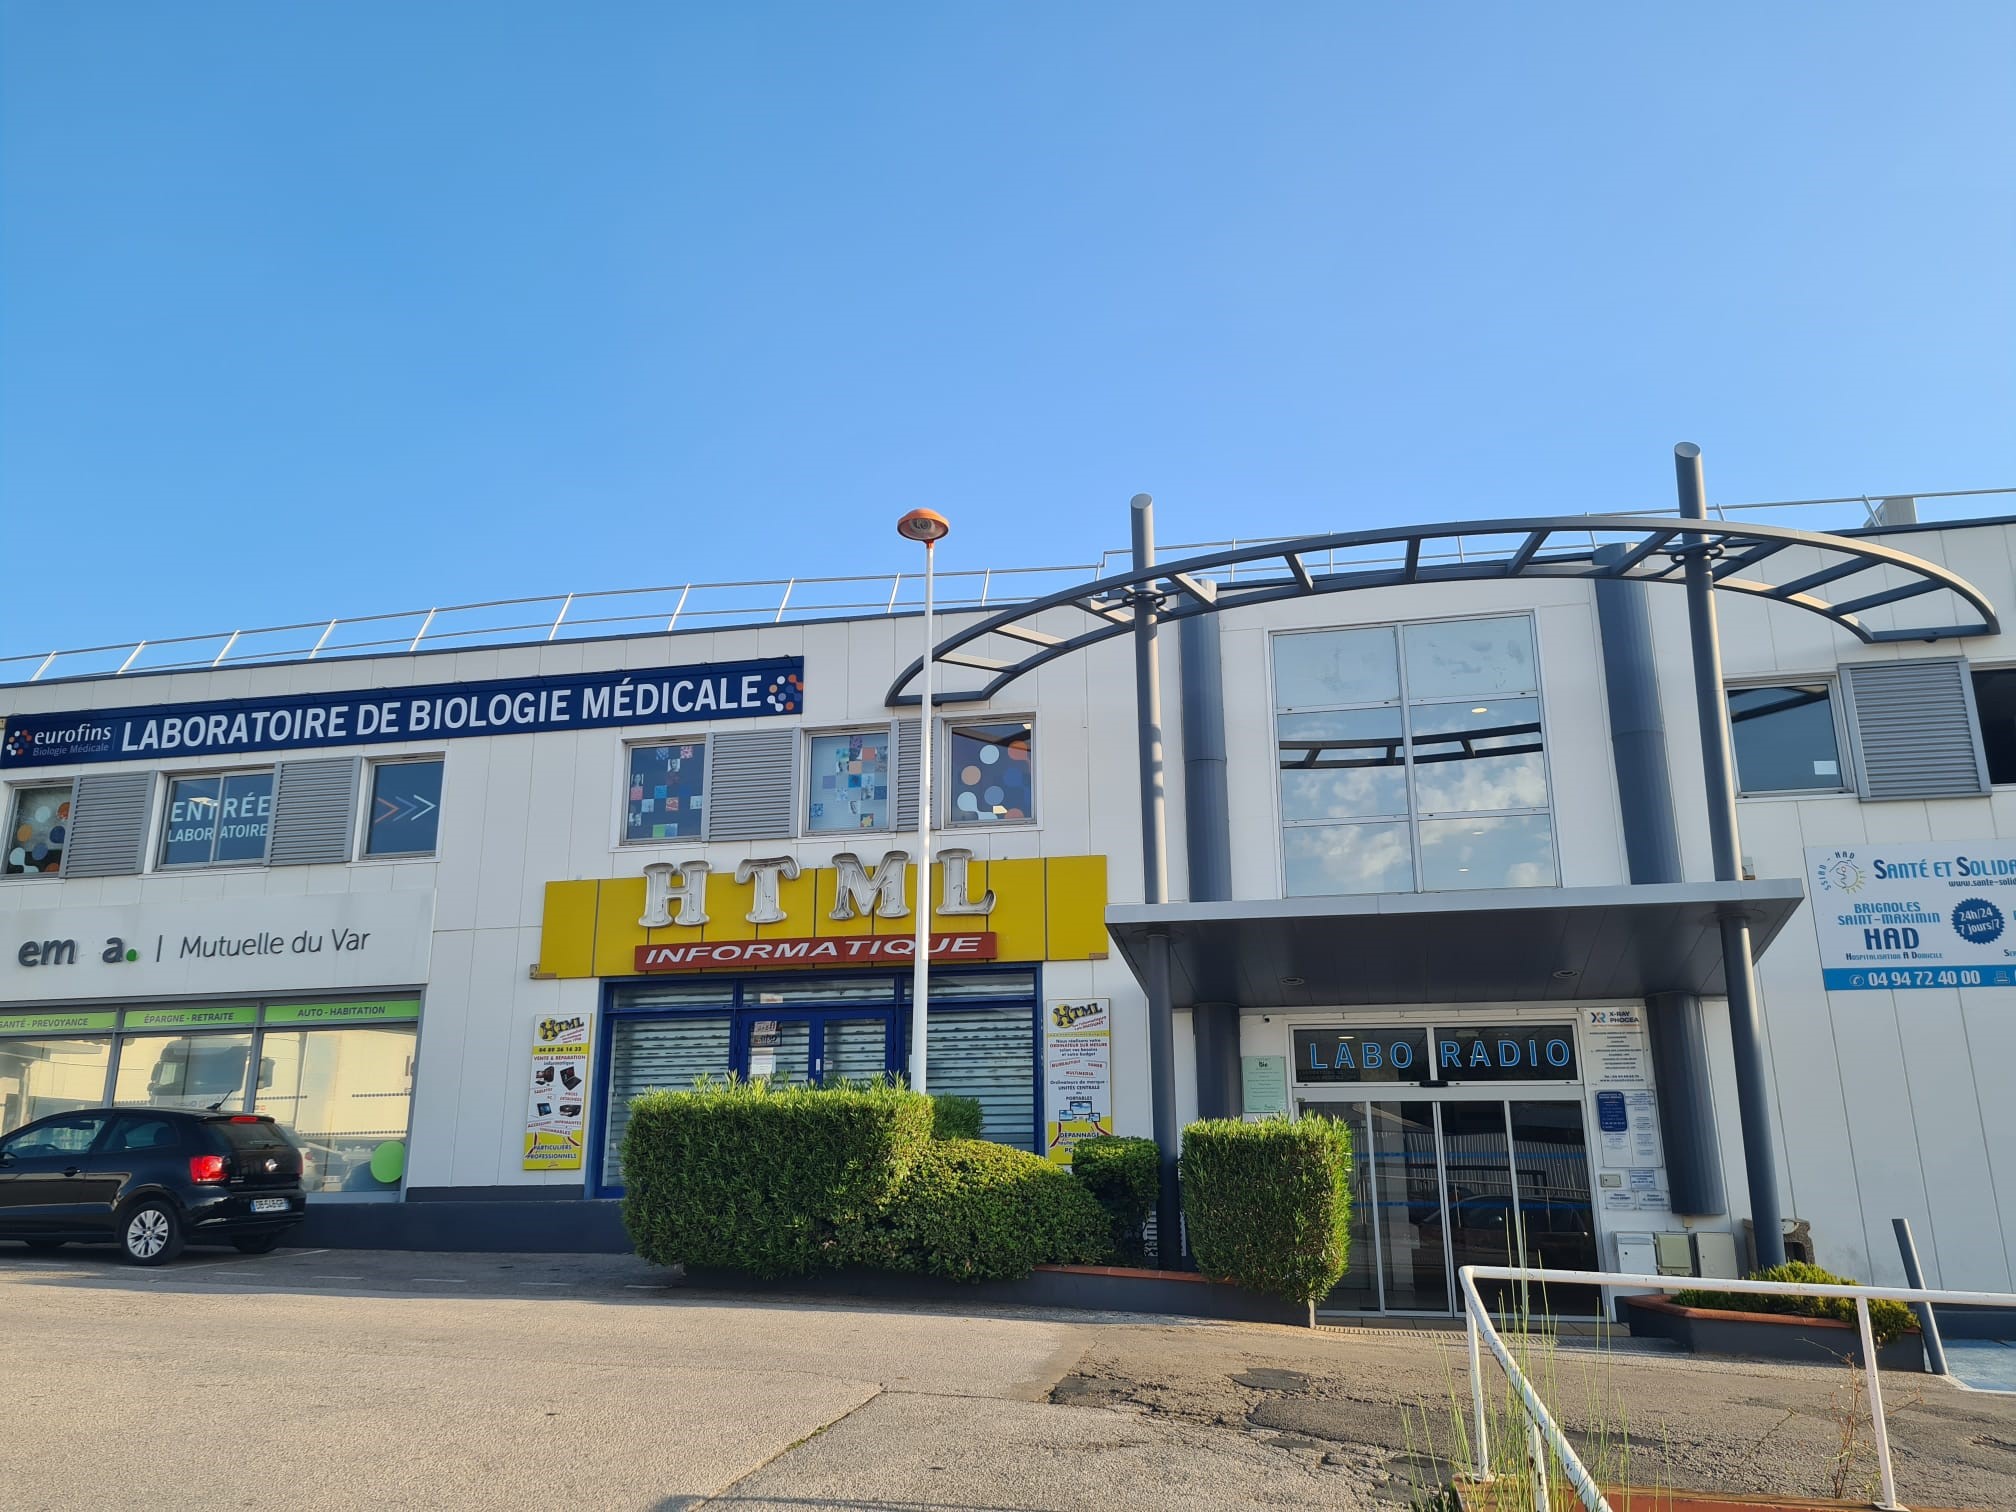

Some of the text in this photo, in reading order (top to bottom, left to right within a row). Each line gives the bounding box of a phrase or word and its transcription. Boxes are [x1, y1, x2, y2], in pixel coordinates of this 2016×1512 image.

[122, 676, 762, 752] LABORATOIRE DE BIOLOGIE MÉDICALE
[34, 723, 112, 745] eurofins
[33, 742, 109, 757] Biologie Médicale
[167, 823, 268, 843] LABORATOIRE
[637, 847, 997, 928] HTML
[1853, 902, 1921, 914] BRIGNOLES
[1959, 906, 1994, 921] 24h/24
[1838, 912, 1940, 926] SAINT-MAXIMIN
[1863, 927, 1920, 950] HAD
[1960, 925, 1965, 935] 7
[179, 928, 371, 959] Mutuelle du Var
[645, 937, 982, 965] INFORMATIQUE
[1868, 970, 1981, 986] 04 94 72 40 00
[144, 1013, 185, 1024] ÉPARGNE
[191, 1012, 234, 1022] RETRAITE
[298, 1008, 322, 1017] AUTO
[330, 1006, 386, 1016] HABITATION
[1052, 1003, 1103, 1027] HTML
[32, 1017, 88, 1028] PREVOYANCE
[538, 1017, 585, 1040] HTML
[1309, 1041, 1414, 1070] LABO
[1439, 1038, 1570, 1068] RADIO
